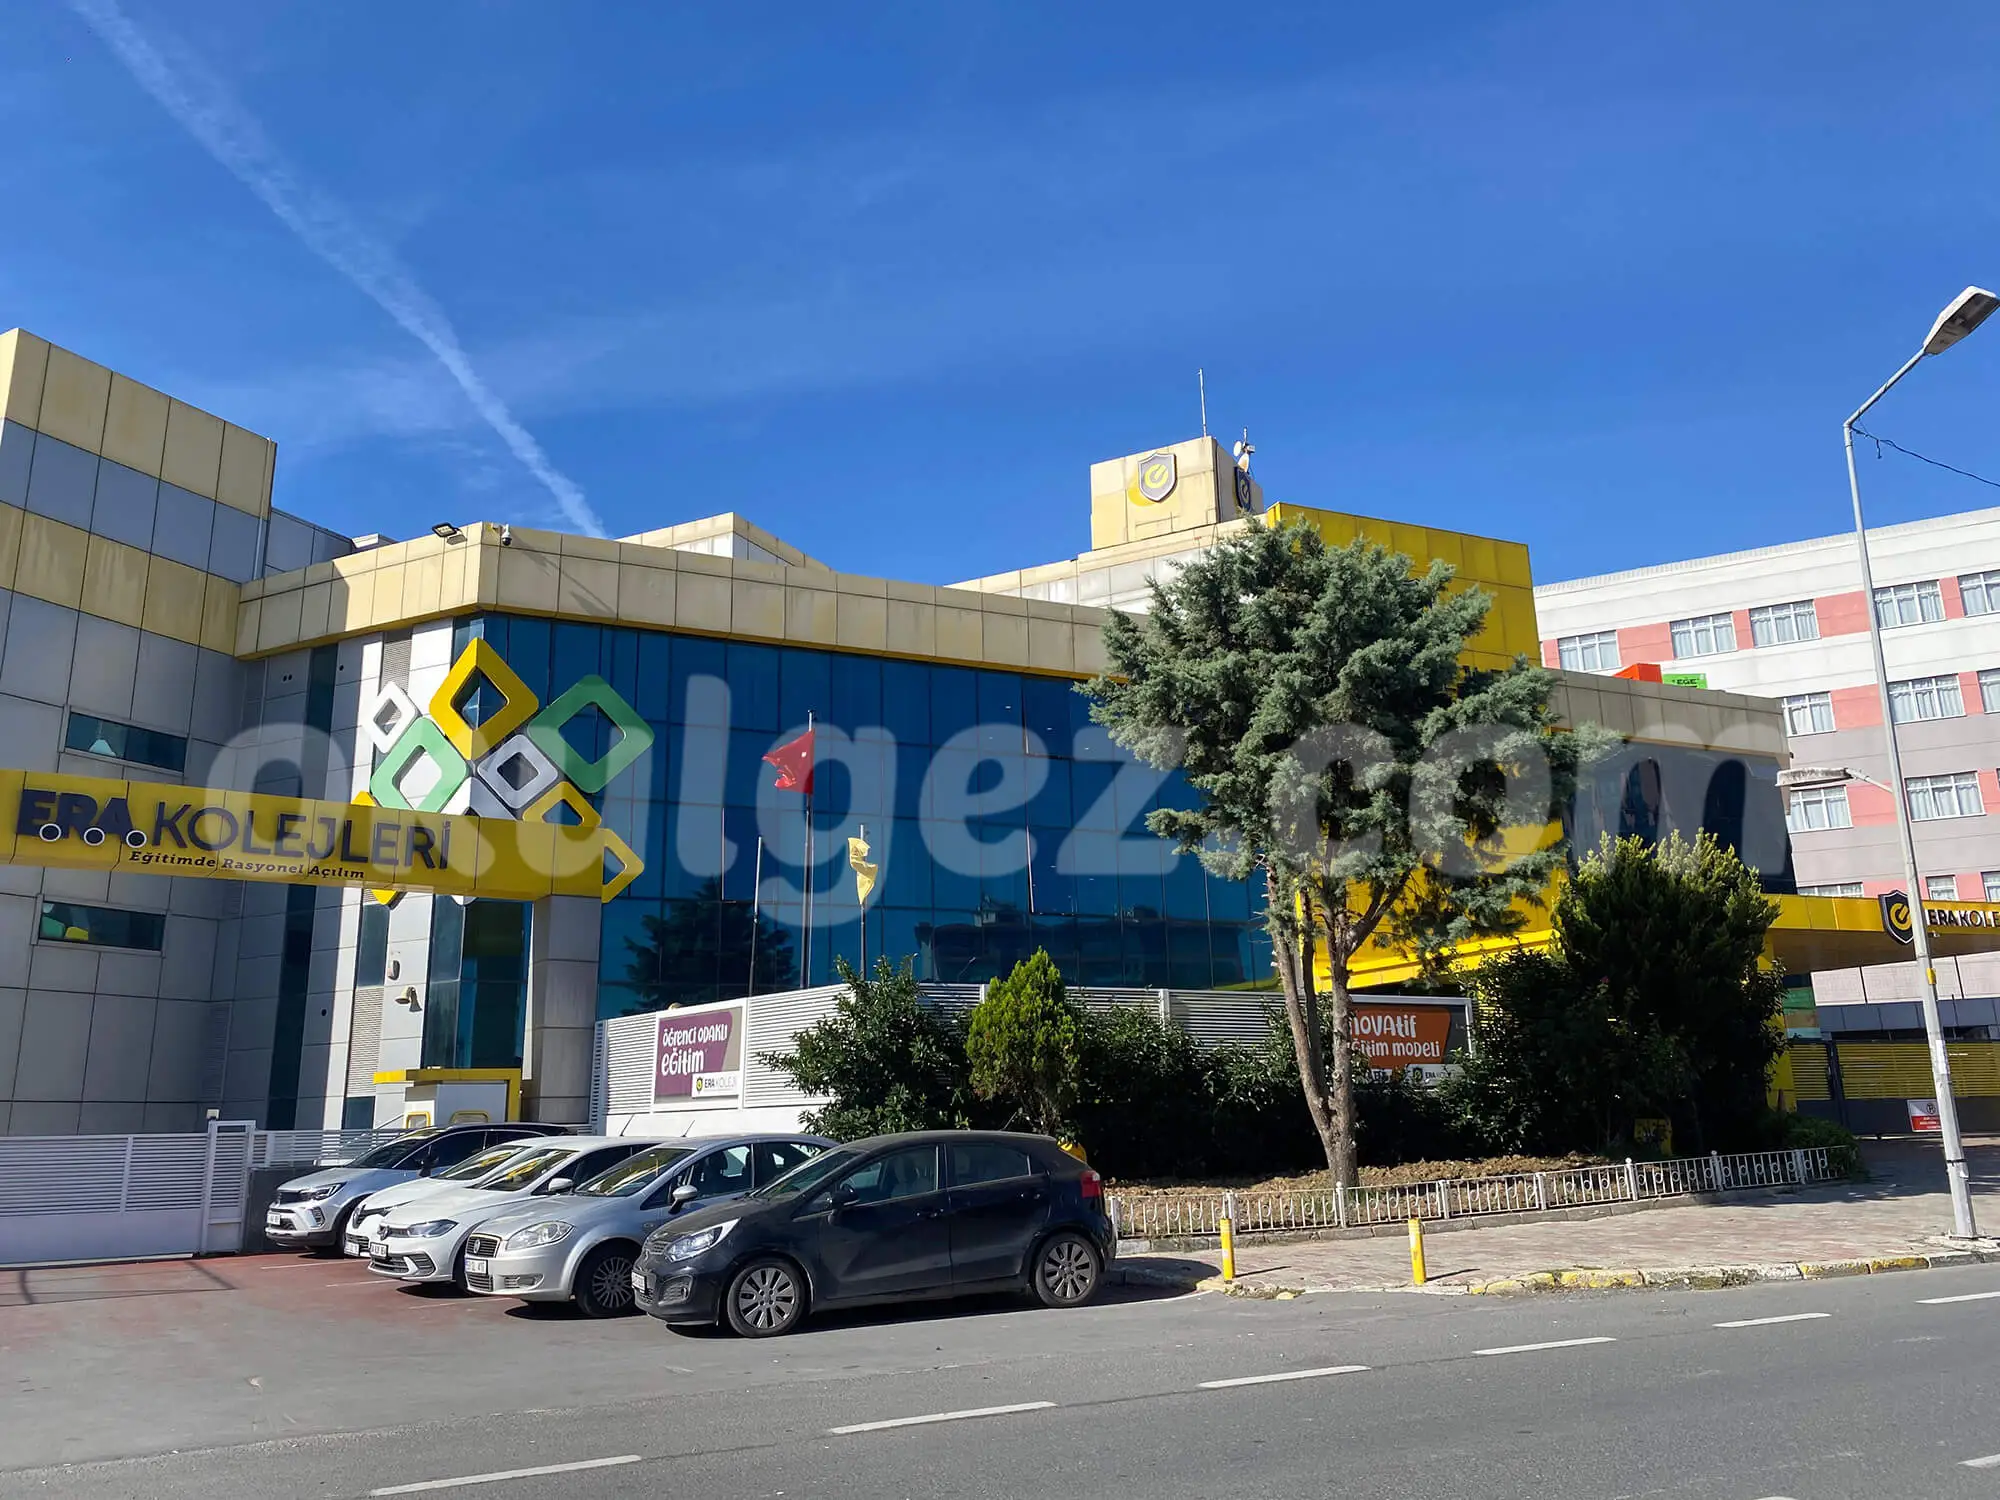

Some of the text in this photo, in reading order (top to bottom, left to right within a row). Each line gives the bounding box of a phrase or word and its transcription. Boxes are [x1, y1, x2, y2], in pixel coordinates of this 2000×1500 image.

[152, 801, 451, 870] KOLEJLERİ
[129, 850, 365, 880] Eğitimde Rasyonel Açılım
[1927, 909, 1960, 926] ERA
[704, 1078, 715, 1088] ERA
